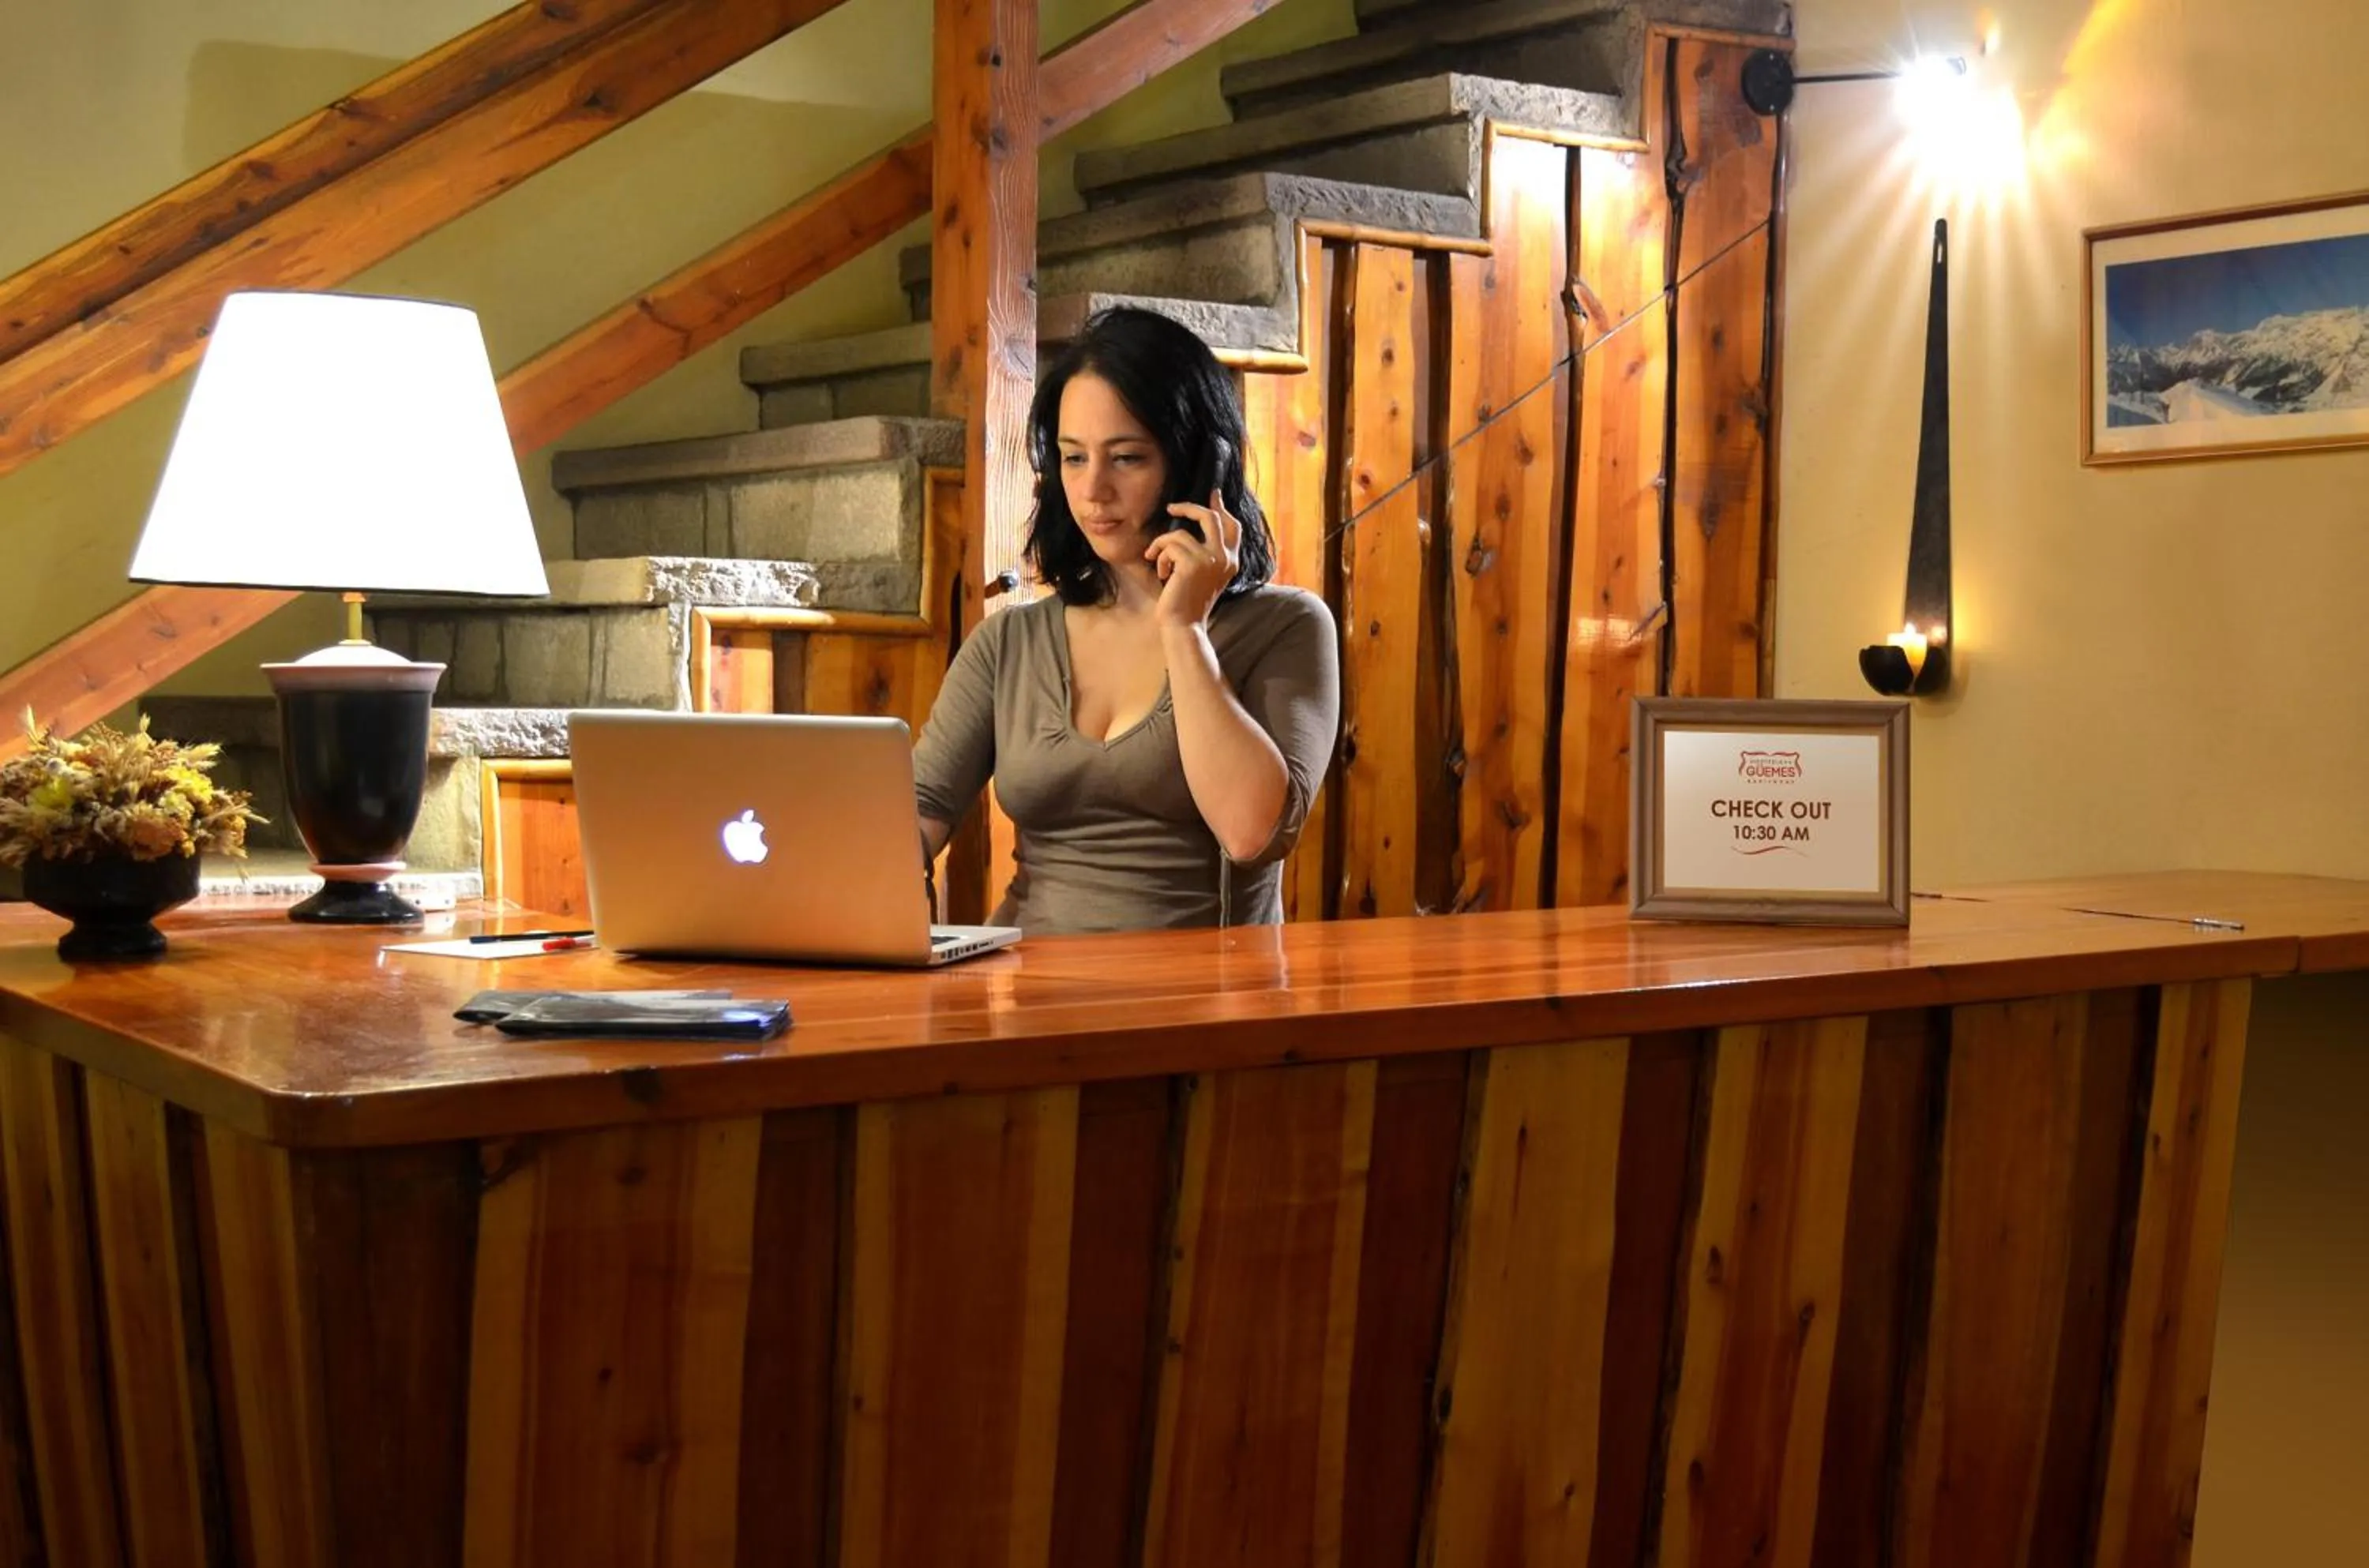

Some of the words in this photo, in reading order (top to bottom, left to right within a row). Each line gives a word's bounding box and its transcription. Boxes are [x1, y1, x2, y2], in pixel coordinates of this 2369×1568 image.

[1711, 800, 1784, 819] CHECK
[1790, 801, 1831, 820] OUT
[1734, 825, 1776, 840] 10:30
[1781, 826, 1810, 841] AM
